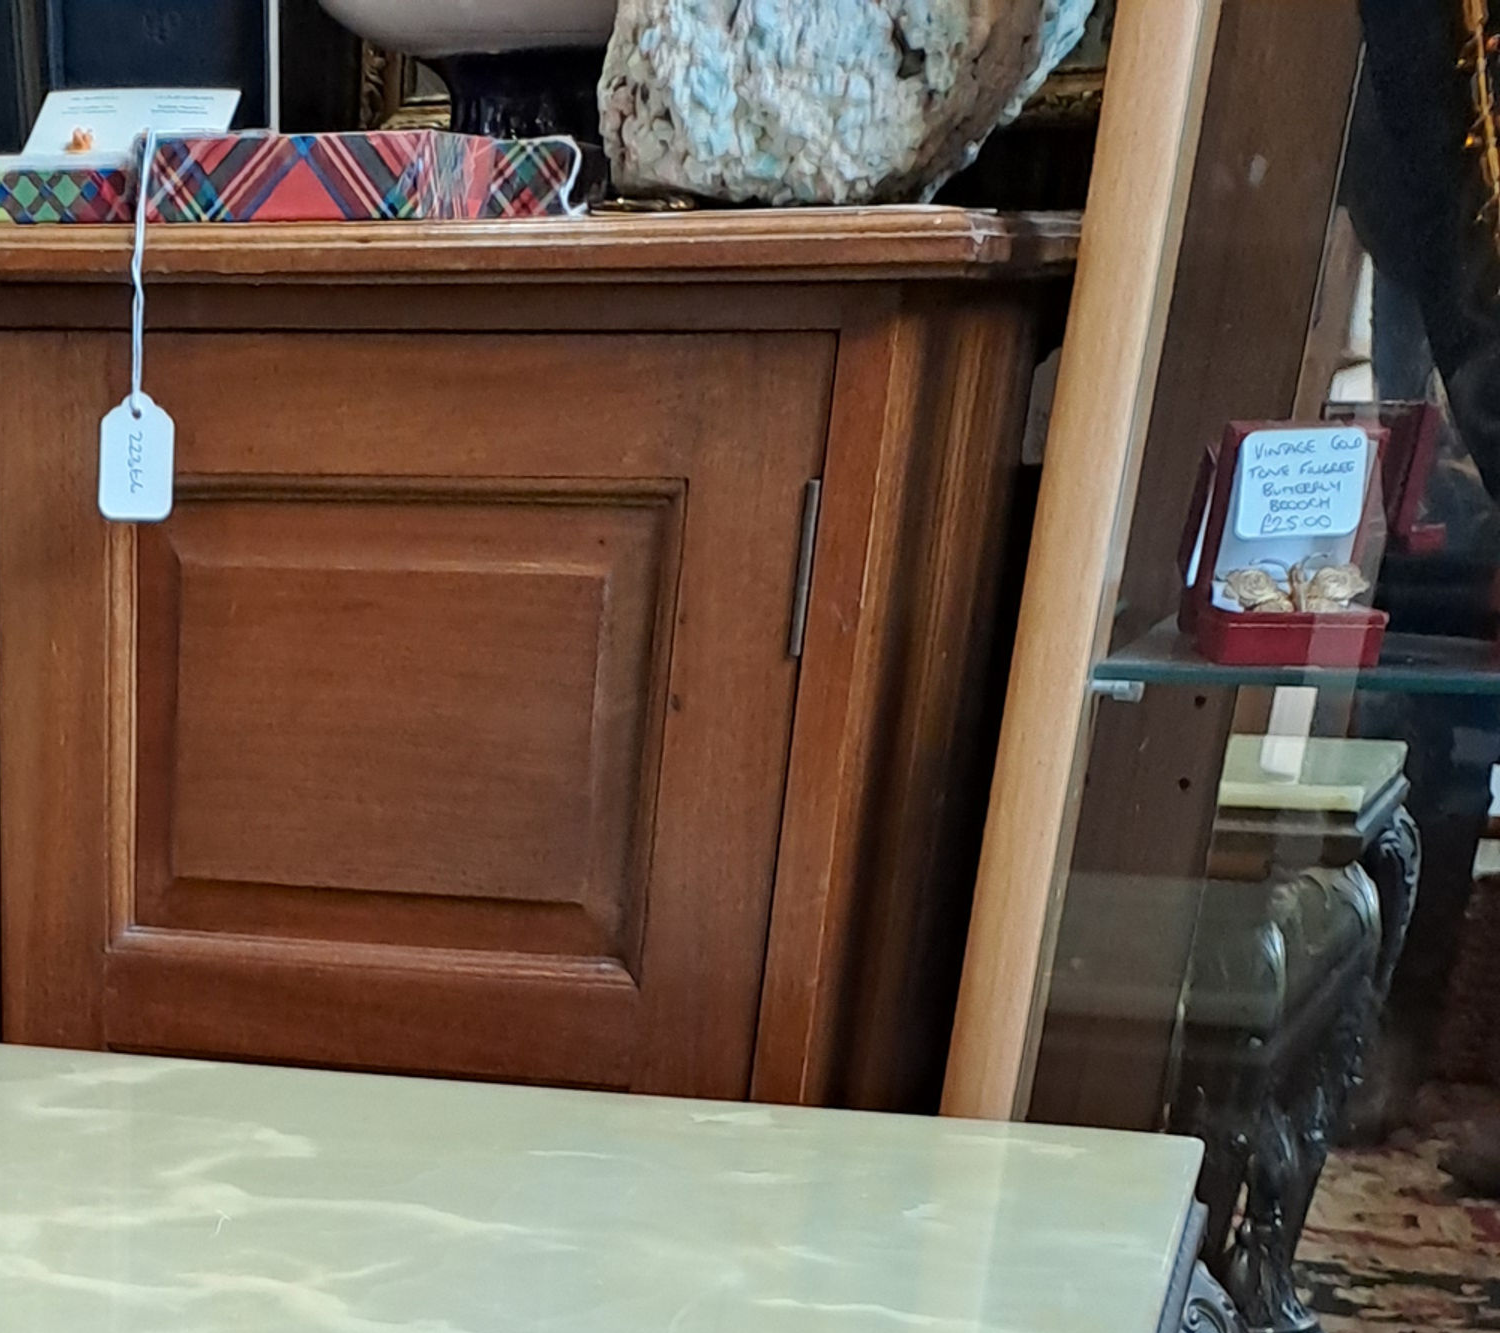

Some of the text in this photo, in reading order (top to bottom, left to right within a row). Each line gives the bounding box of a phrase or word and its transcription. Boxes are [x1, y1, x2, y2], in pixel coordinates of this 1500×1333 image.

[1255, 439, 1316, 460] VINTAGE
[1249, 464, 1290, 479] TONE
[1269, 497, 1331, 512] BROOCH
